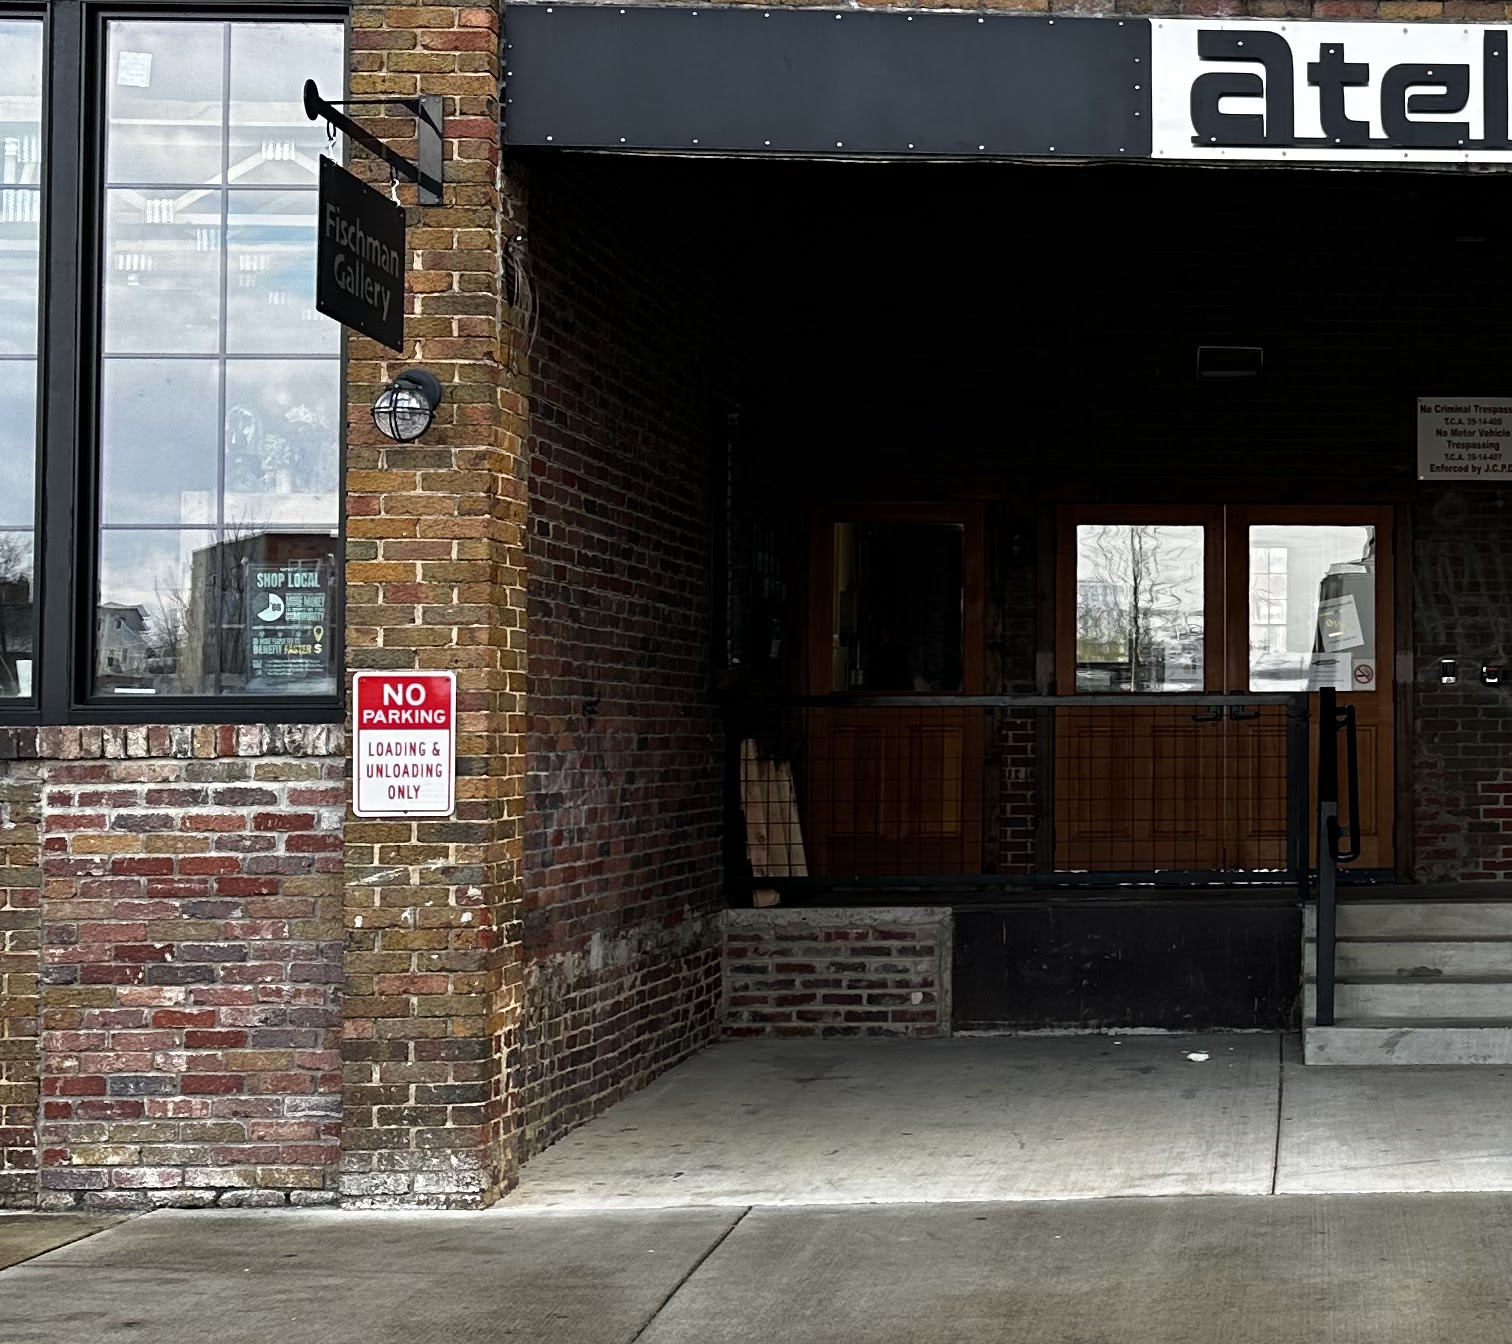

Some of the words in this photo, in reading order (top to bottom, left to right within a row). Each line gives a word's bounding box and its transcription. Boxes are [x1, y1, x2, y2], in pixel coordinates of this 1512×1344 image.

[325, 202, 399, 278] Fischman
[334, 253, 391, 322] Gallery
[1420, 405, 1432, 414] No
[1434, 404, 1471, 414] Criminal
[1436, 429, 1448, 437] No
[1451, 429, 1476, 437] Motor
[1478, 428, 1511, 437] Vehicle
[1447, 440, 1500, 451] Trespassing
[1430, 463, 1469, 473] Enforced
[1471, 463, 1482, 475] by
[256, 572, 285, 588] SHOP
[287, 572, 321, 588] LOCAL
[383, 683, 426, 706] NO
[362, 709, 446, 724] PARKING
[368, 742, 426, 757] LOADING
[432, 742, 440, 756] &
[366, 763, 443, 778] UNLOADING
[388, 785, 421, 800] ONLY
